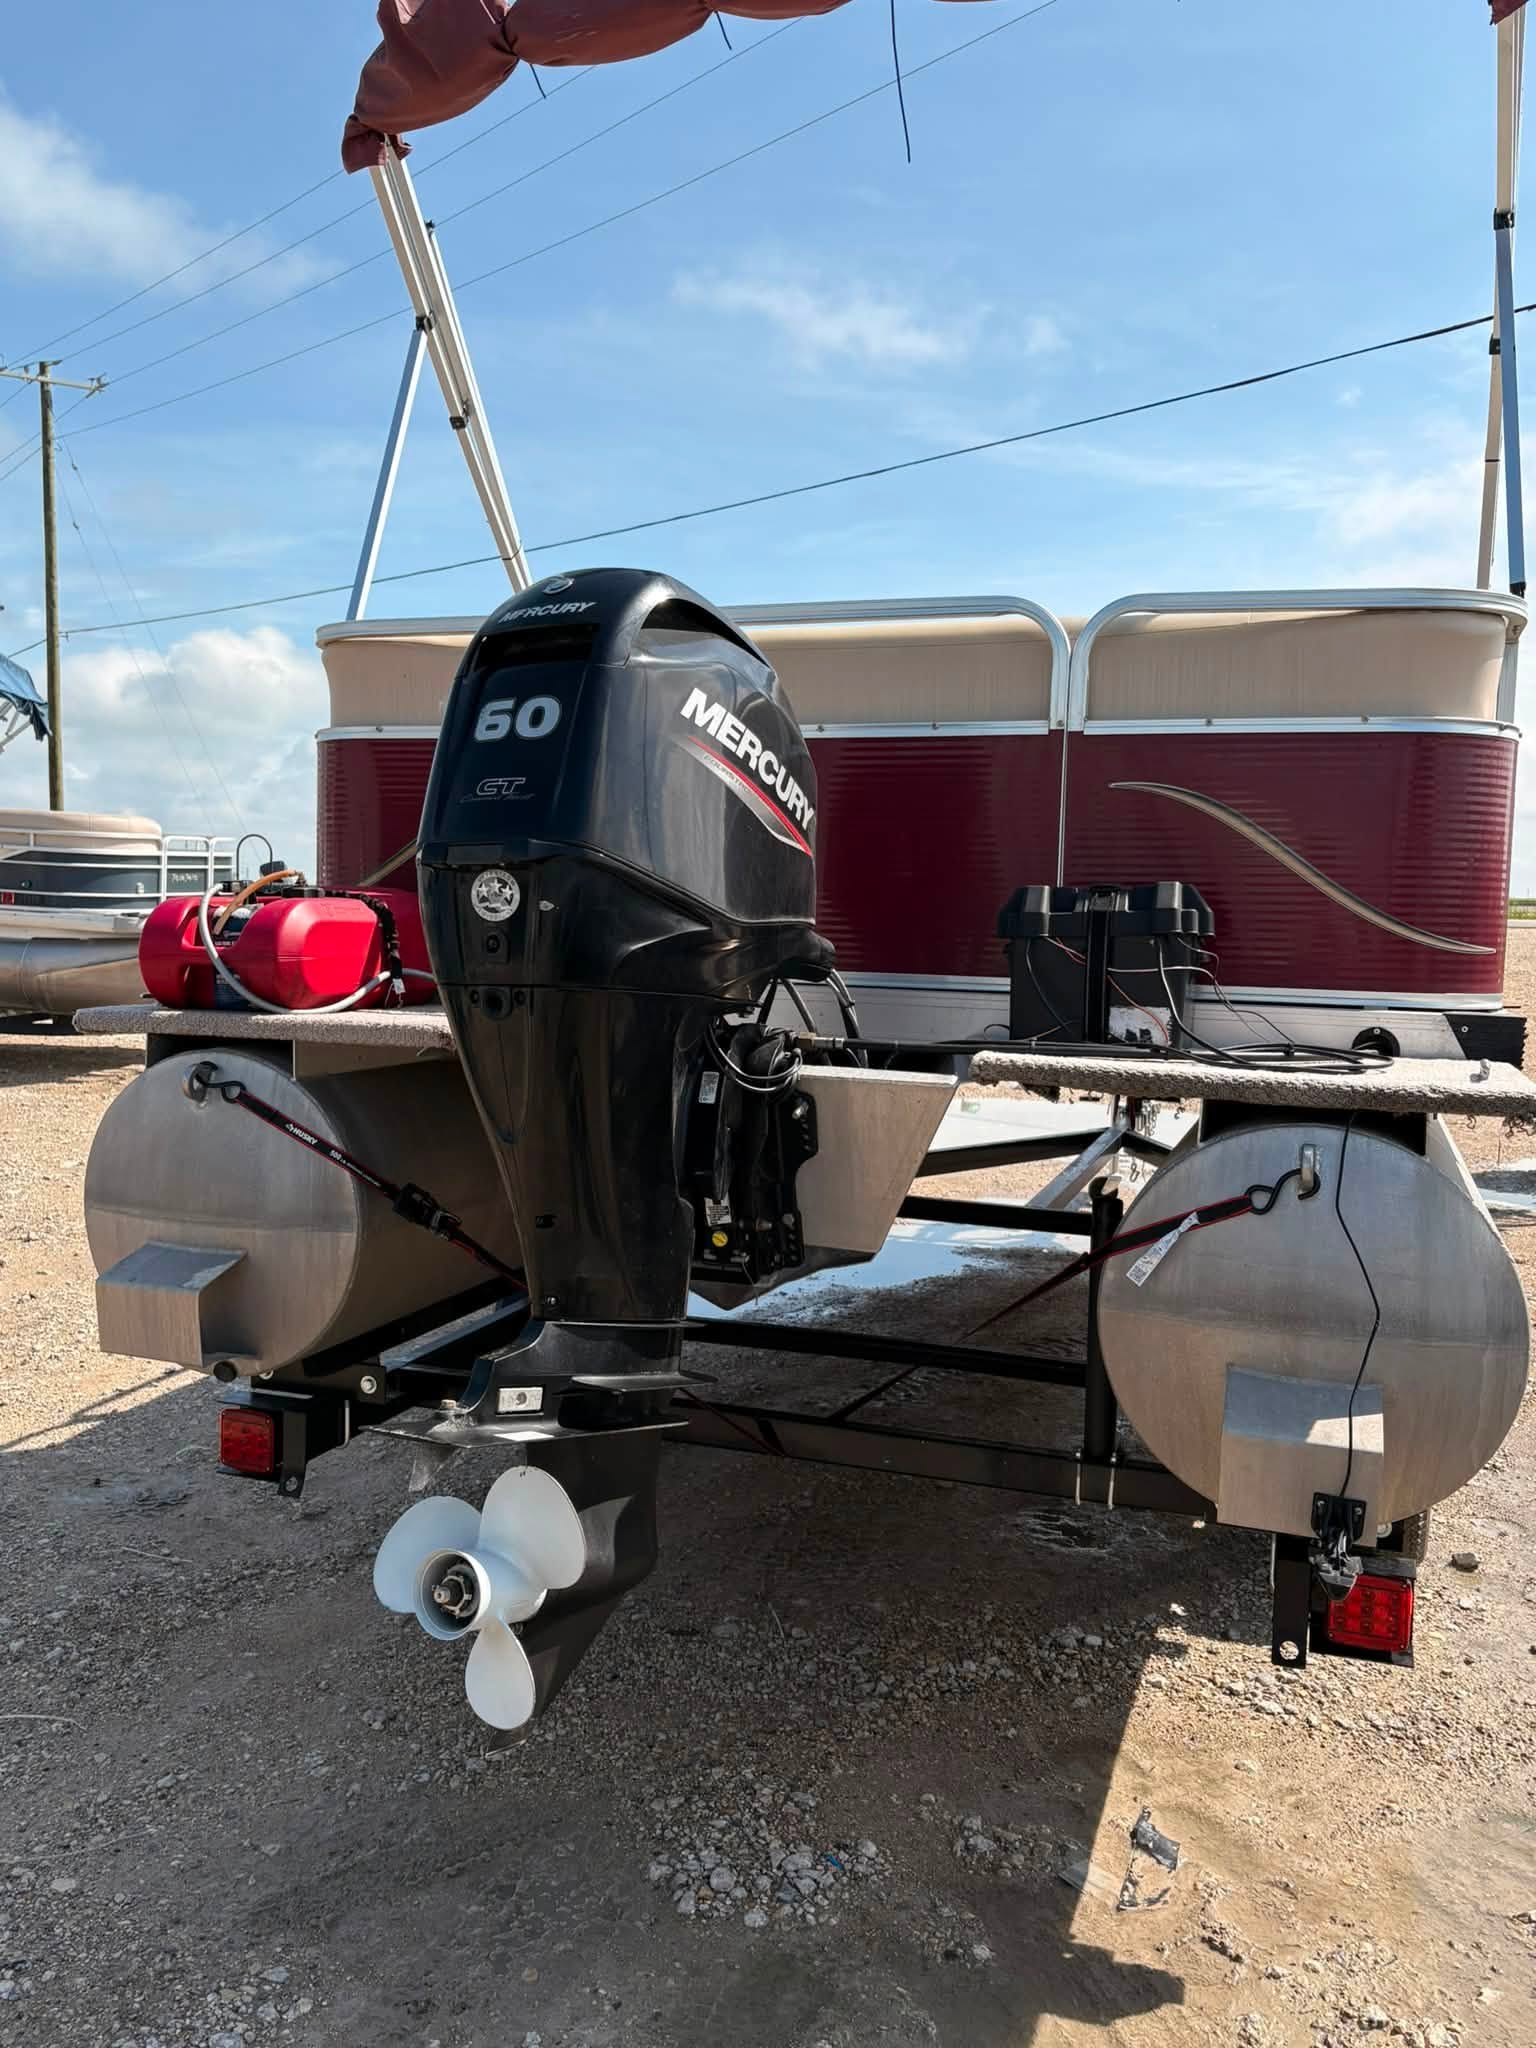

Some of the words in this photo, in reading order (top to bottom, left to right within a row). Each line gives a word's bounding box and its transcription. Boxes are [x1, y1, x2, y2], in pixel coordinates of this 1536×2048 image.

[498, 602, 597, 624] MERCURY
[474, 697, 560, 741] 60
[680, 687, 815, 831] MERCURY
[476, 777, 526, 796] GT
